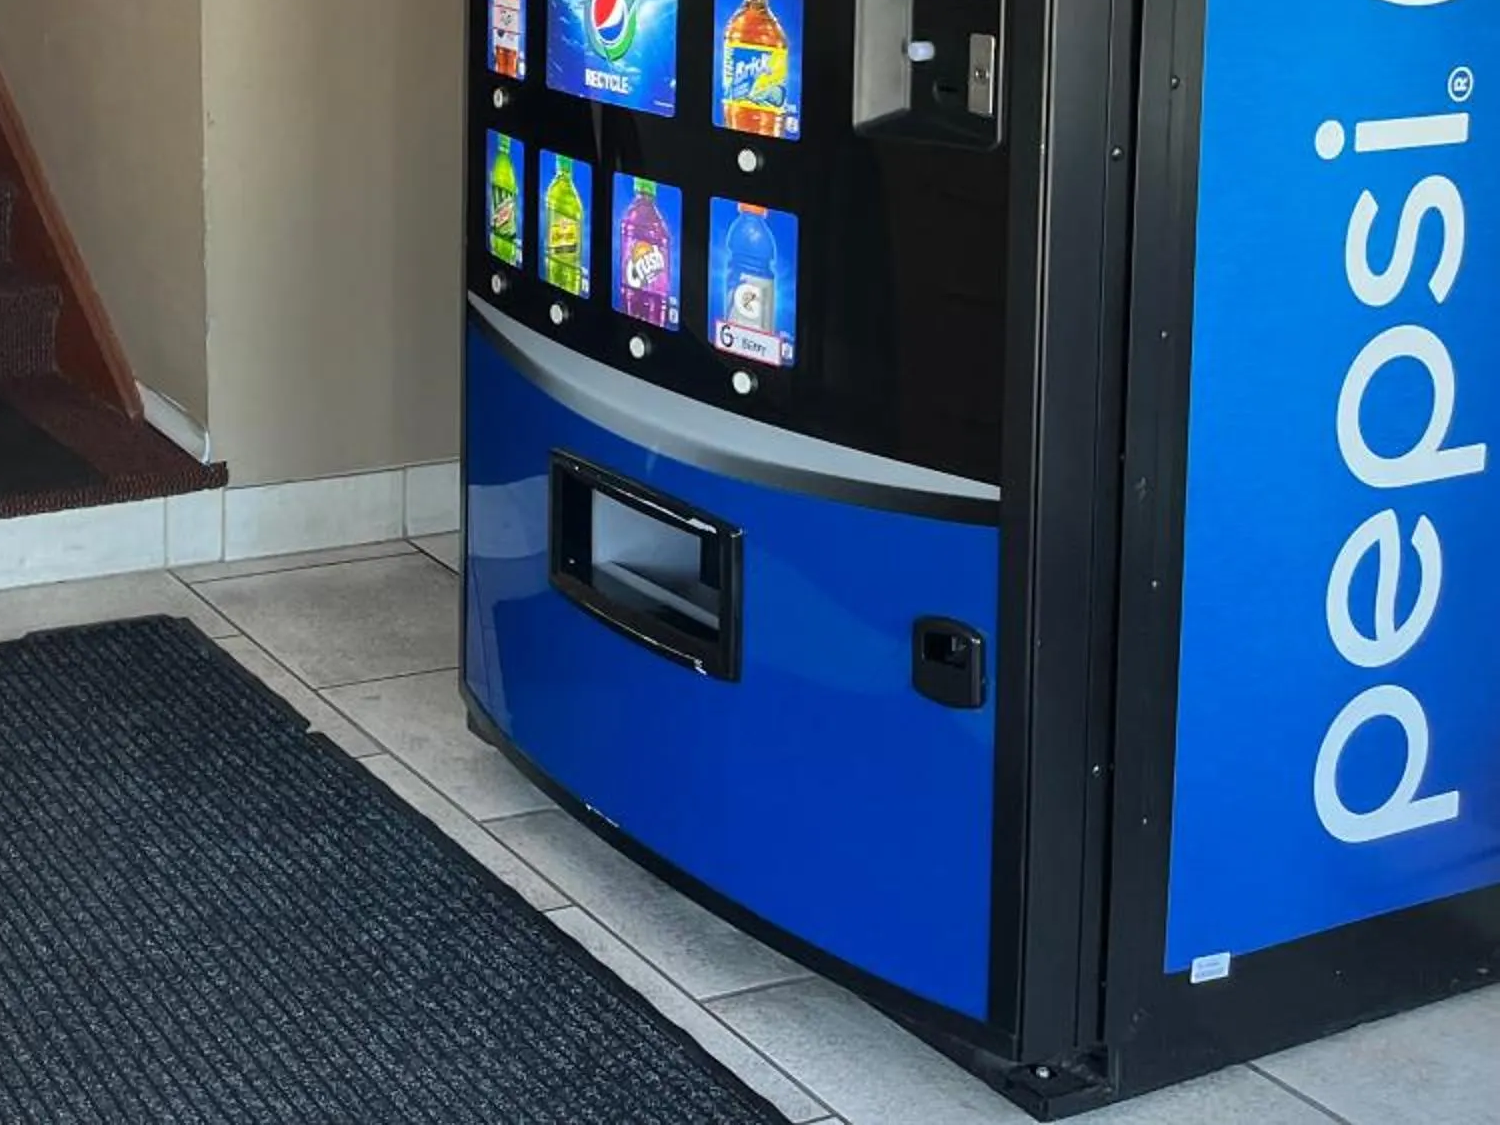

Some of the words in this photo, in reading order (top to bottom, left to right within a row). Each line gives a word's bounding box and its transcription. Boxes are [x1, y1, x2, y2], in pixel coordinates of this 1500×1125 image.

[585, 68, 629, 94] RECYCLE
[626, 244, 665, 288] Crush
[1314, 111, 1487, 844] pepsi
